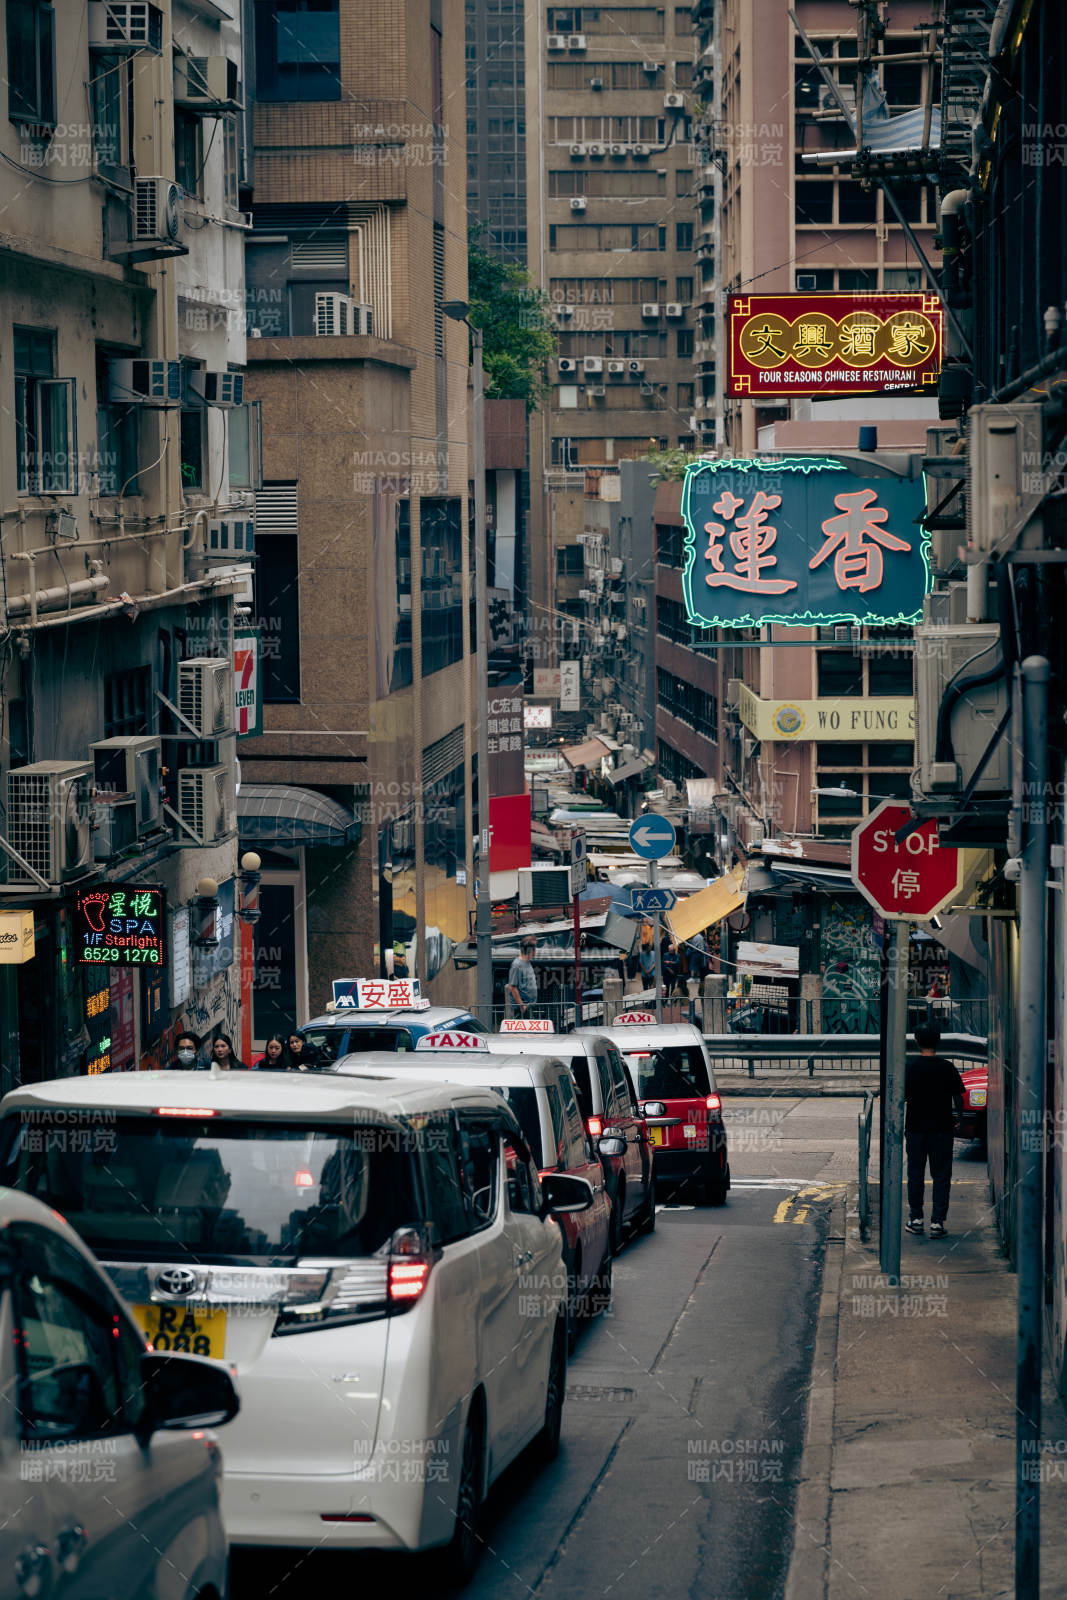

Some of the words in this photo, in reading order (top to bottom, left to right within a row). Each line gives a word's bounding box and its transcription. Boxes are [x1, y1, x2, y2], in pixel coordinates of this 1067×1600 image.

[747, 322, 929, 358] 文興酒家
[759, 371, 782, 383] FOUR
[784, 371, 823, 383] SEASONS
[824, 370, 861, 382] CHINESE
[704, 488, 912, 595] 蓮香
[818, 711, 840, 730] WO
[851, 710, 898, 729] FUNG
[891, 868, 920, 899] 停
[109, 919, 155, 934] SPA
[83, 932, 103, 945] 1/F
[105, 934, 158, 949] Starlight
[84, 947, 119, 961] 6529
[124, 949, 159, 963] 1276
[336, 995, 356, 1007] AXA
[361, 981, 412, 1008] 安盛
[504, 1020, 550, 1031] TAXI
[619, 1013, 651, 1023] TAXI
[426, 1033, 478, 1047] TAXI
[159, 1306, 198, 1334] RA
[146, 1332, 211, 1356] 088
